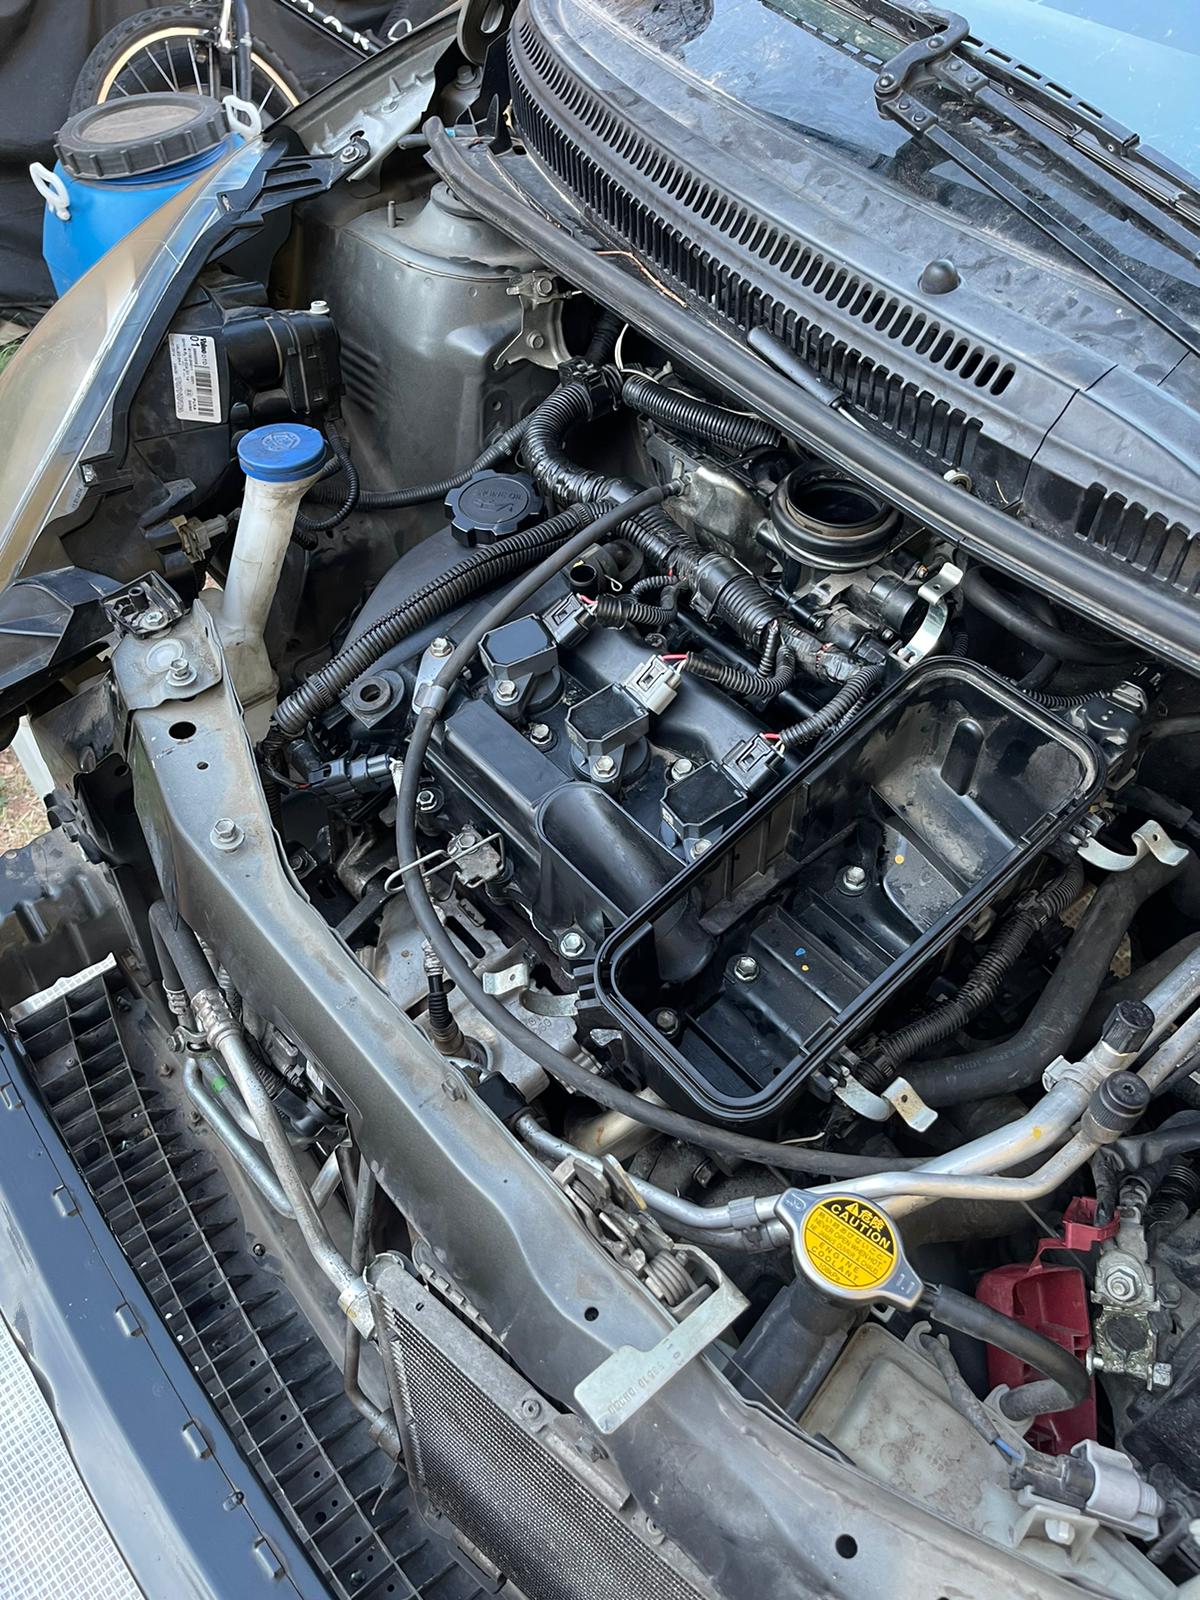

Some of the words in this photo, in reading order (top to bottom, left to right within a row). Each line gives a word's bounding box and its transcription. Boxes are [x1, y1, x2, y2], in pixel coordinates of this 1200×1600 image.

[190, 335, 200, 347] 01
[830, 1203, 891, 1249] CAUTION
[859, 1209, 885, 1232] 危険
[815, 1218, 834, 1235] NEVER
[834, 1231, 850, 1246] OPEN
[849, 1241, 868, 1259] WHEN
[811, 1245, 860, 1281] COOLANT
[819, 1241, 860, 1273] ENGINE
